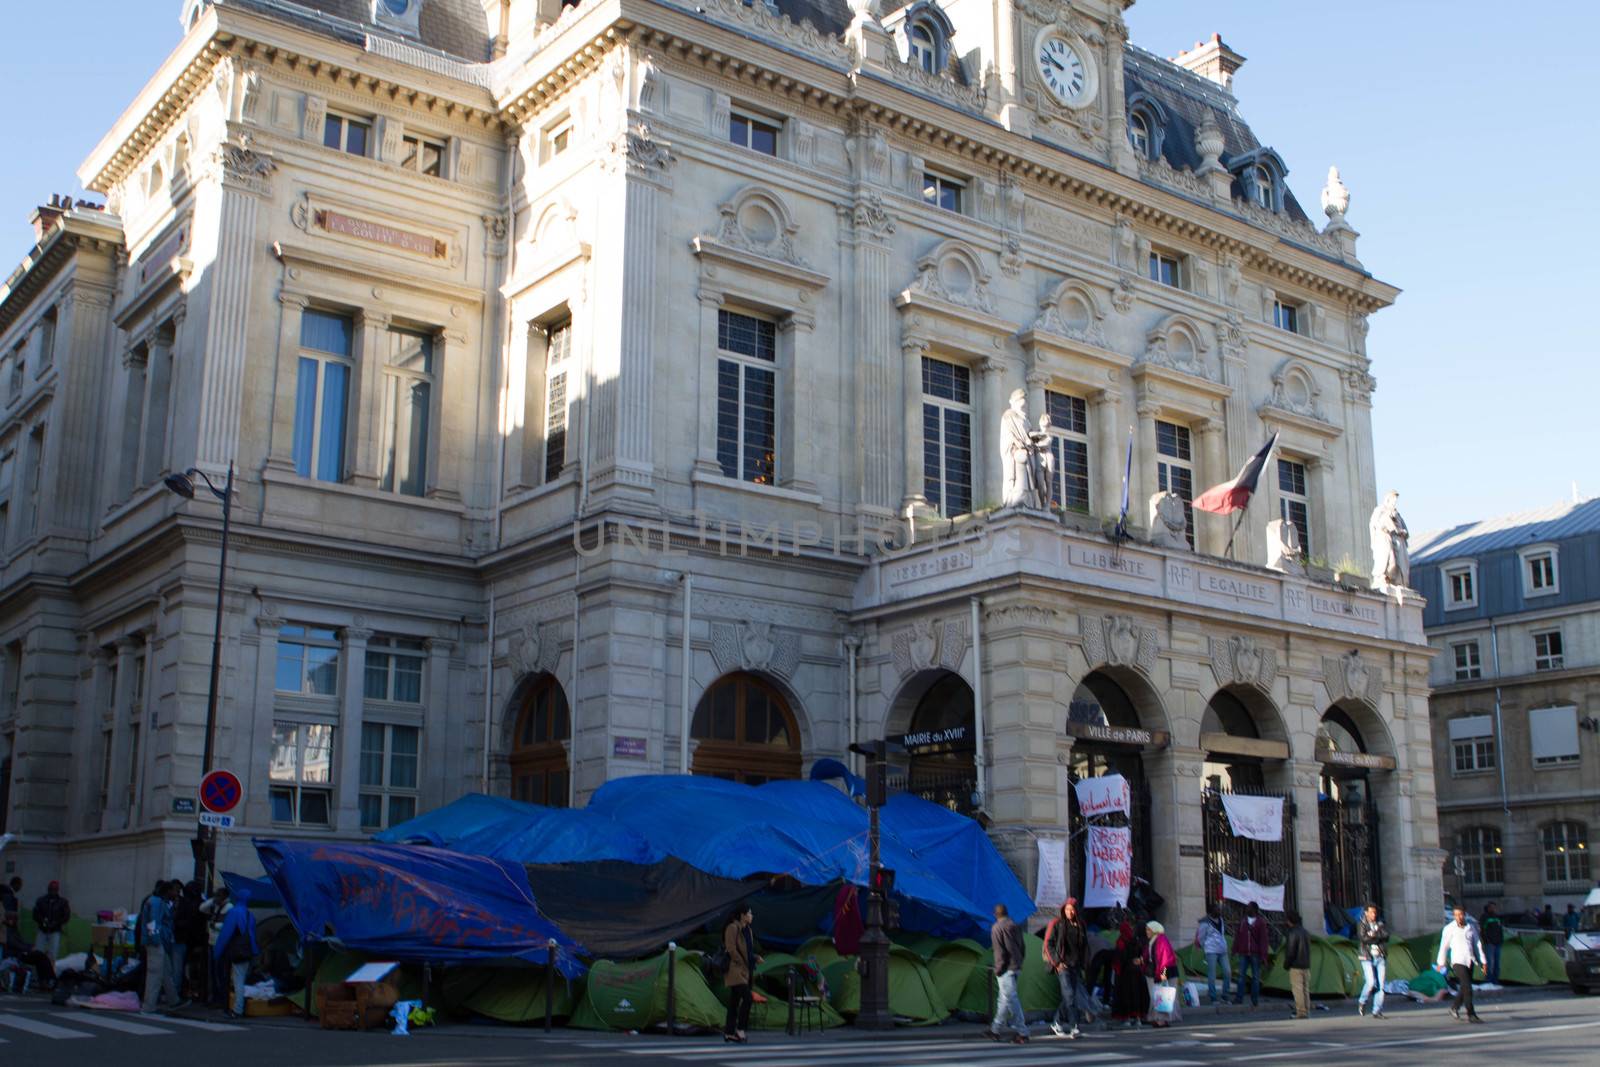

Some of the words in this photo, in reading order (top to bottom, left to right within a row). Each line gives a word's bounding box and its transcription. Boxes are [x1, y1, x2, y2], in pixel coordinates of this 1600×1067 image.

[904, 731, 931, 746] MAIRIE
[932, 732, 943, 743] du
[1089, 725, 1112, 739] VILLE
[1113, 730, 1125, 741] de
[1126, 729, 1151, 743] PARIS
